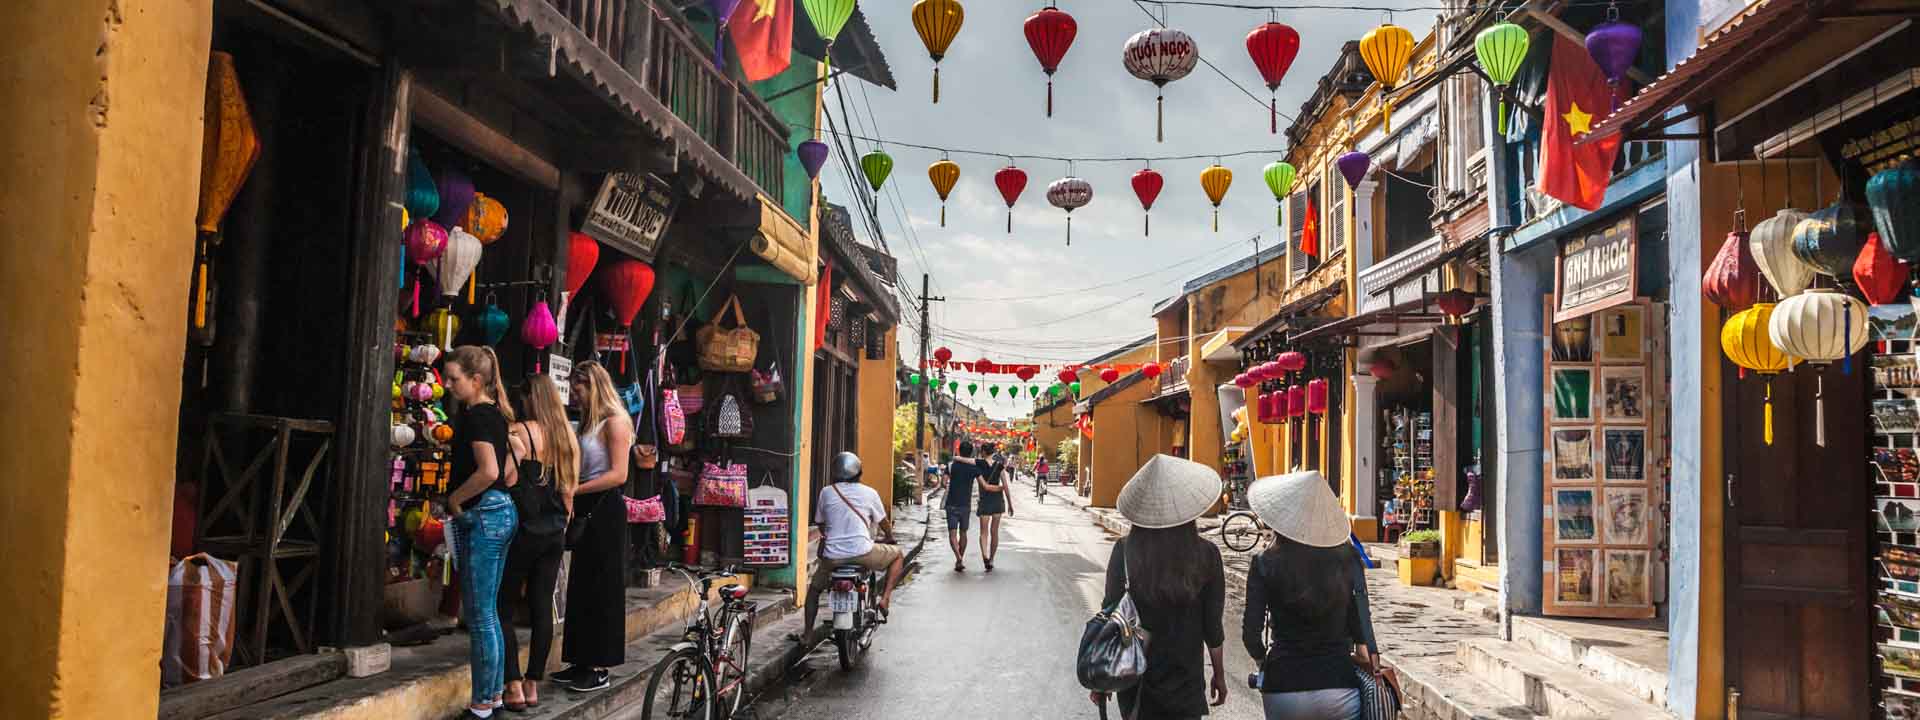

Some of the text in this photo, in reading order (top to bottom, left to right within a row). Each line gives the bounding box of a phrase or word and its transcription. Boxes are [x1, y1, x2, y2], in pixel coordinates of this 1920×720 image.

[1160, 41, 1190, 59] NGỌC
[1566, 249, 1592, 288] ANH
[1592, 237, 1628, 278] KHOA
